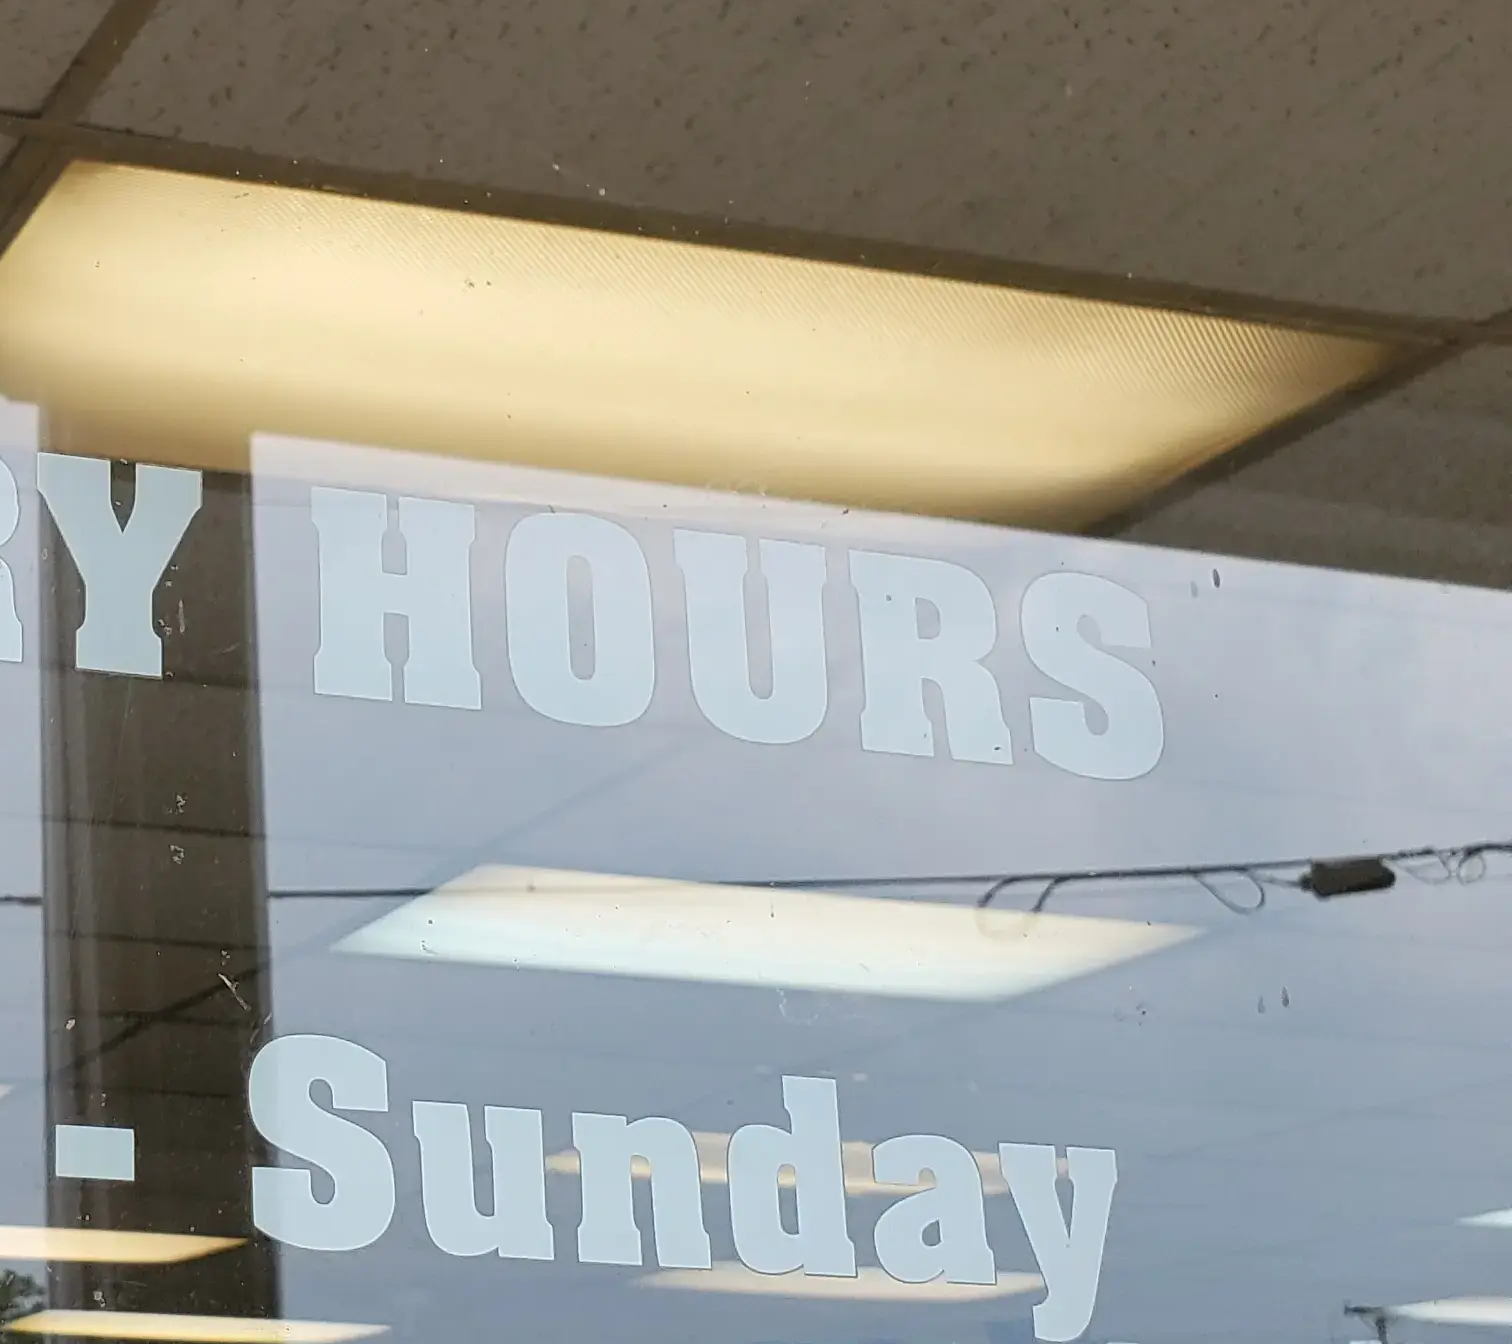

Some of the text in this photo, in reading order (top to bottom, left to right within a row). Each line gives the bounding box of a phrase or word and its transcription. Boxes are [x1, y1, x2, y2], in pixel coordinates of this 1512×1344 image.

[310, 486, 1165, 781] HOURS
[54, 1124, 136, 1182] -
[248, 1033, 1118, 1342] Sunday
